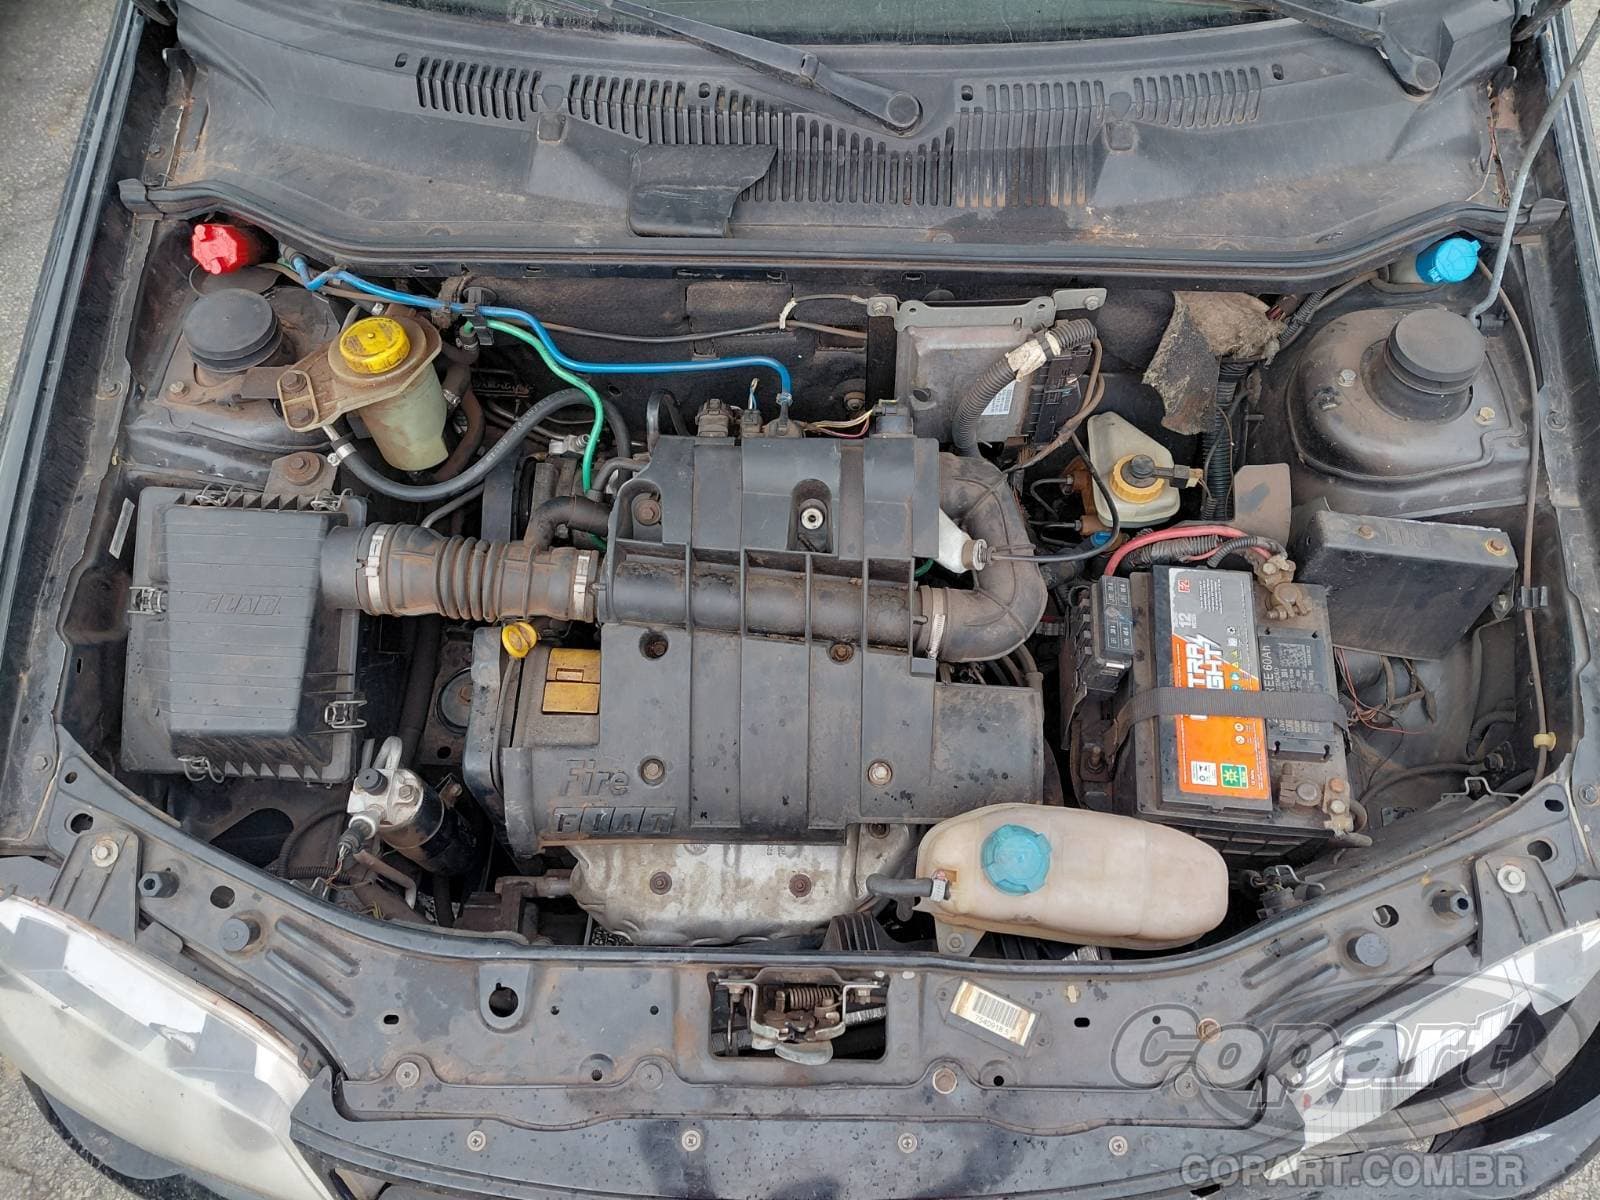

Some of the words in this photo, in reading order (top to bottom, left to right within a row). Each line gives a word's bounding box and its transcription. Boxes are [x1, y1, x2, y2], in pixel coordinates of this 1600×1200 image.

[1260, 645, 1273, 671] 60Ah
[559, 759, 630, 797] Fire
[555, 807, 676, 833] FIAT
